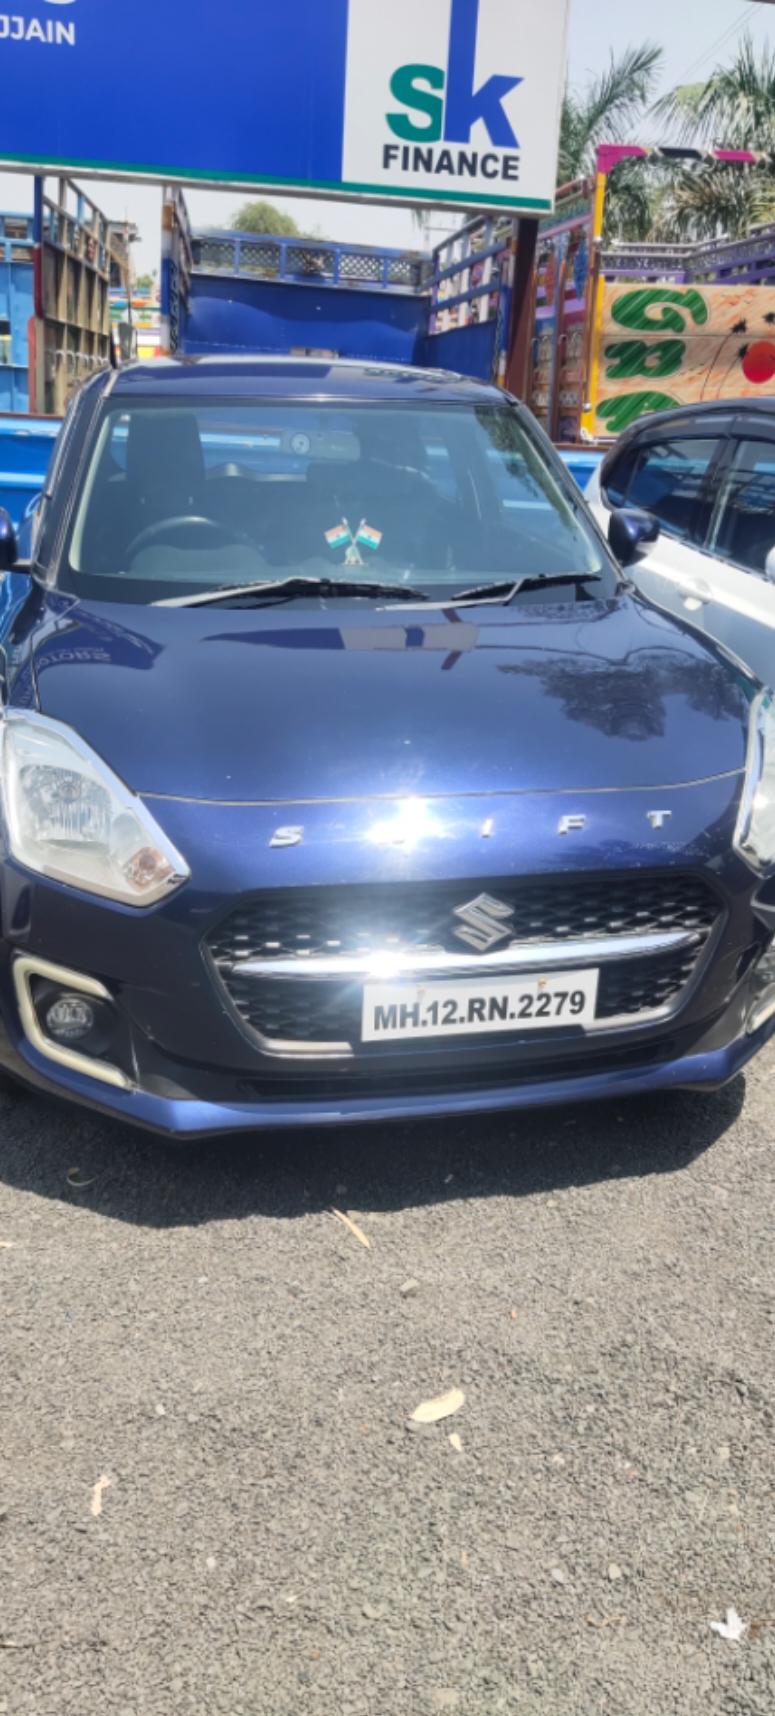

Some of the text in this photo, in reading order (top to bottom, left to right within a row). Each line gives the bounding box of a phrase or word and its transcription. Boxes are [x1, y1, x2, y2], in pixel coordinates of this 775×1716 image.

[382, 144, 520, 181] FINANCE
[268, 808, 672, 848] SIFT
[373, 990, 587, 1031] MH.12.RN.2279
